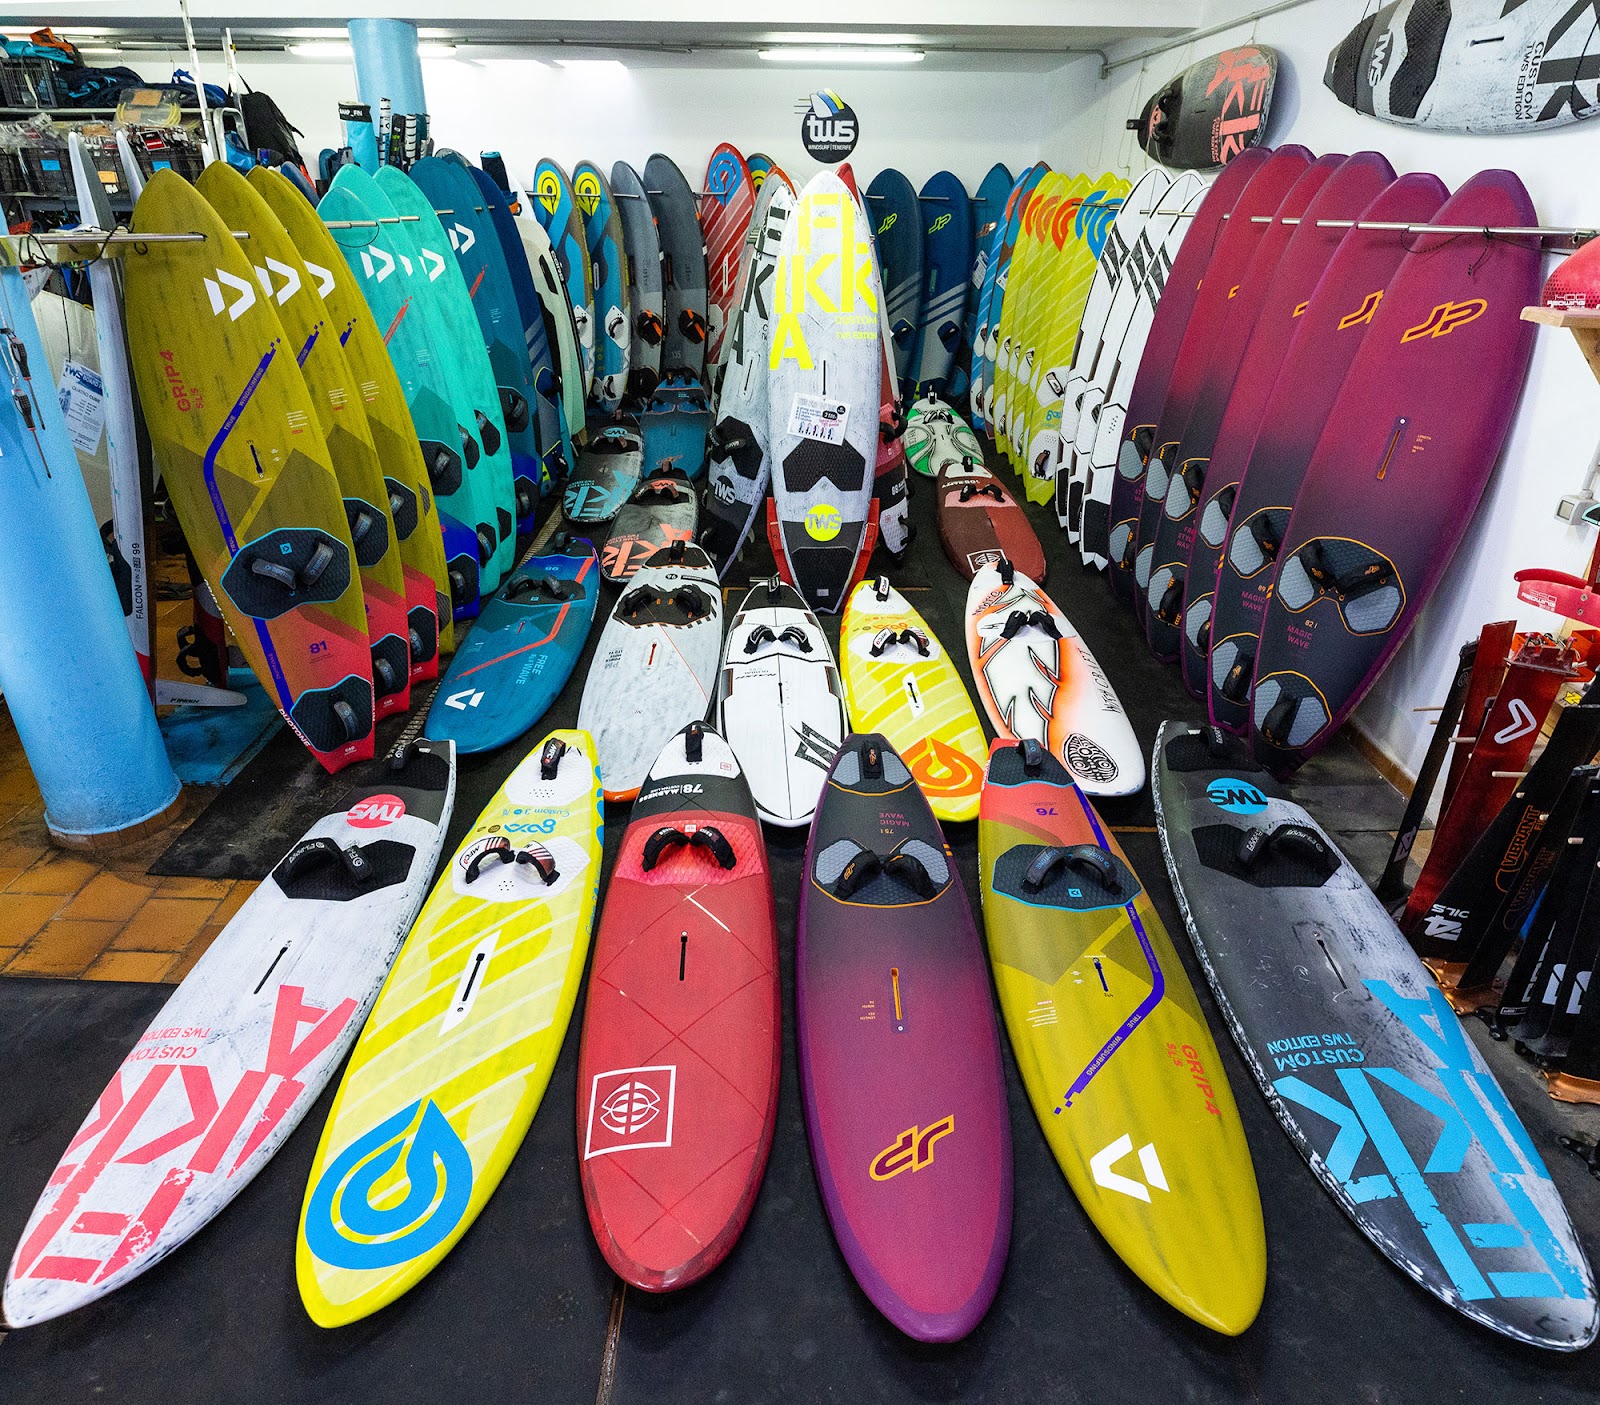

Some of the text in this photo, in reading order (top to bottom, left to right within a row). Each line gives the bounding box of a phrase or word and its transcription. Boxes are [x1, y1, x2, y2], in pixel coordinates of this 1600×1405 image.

[1369, 30, 1393, 87] TWS
[1515, 43, 1534, 120] TWS EDITION
[1524, 41, 1545, 120] CUSTOM
[1400, 298, 1488, 344] JP
[223, 366, 266, 432] TRUE WINDSURFING
[714, 481, 736, 504] TWS
[806, 513, 842, 530] TWS
[132, 542, 141, 556] 99
[135, 584, 144, 620] FALCON
[1241, 590, 1266, 604] MAGIC
[1241, 600, 1263, 612] WAVE
[1287, 624, 1314, 640] MAGIC
[309, 640, 328, 654] 81
[1287, 634, 1310, 649] WAVE
[515, 663, 532, 685] WAVE
[530, 654, 548, 676] FREE
[278, 707, 311, 748] DUOTONE
[638, 788, 680, 803] MADNESS
[682, 782, 703, 794] 78
[1207, 789, 1268, 806] TWS
[346, 801, 405, 822] TWS
[534, 807, 570, 816] Custom
[879, 812, 905, 820] WAVE
[1035, 807, 1059, 816] 76
[504, 819, 556, 834] goya
[879, 819, 910, 827] MAGIC
[1501, 804, 1543, 868] VIBRANT
[140, 1026, 211, 1042] TWS EDITION
[1267, 1032, 1356, 1054] TWS EDITION
[1085, 1012, 1141, 1077] TRUE WINDSURFING
[121, 1045, 198, 1063] CUSTOM
[1273, 1047, 1365, 1071] CUSTOM
[868, 1113, 955, 1182] JP
